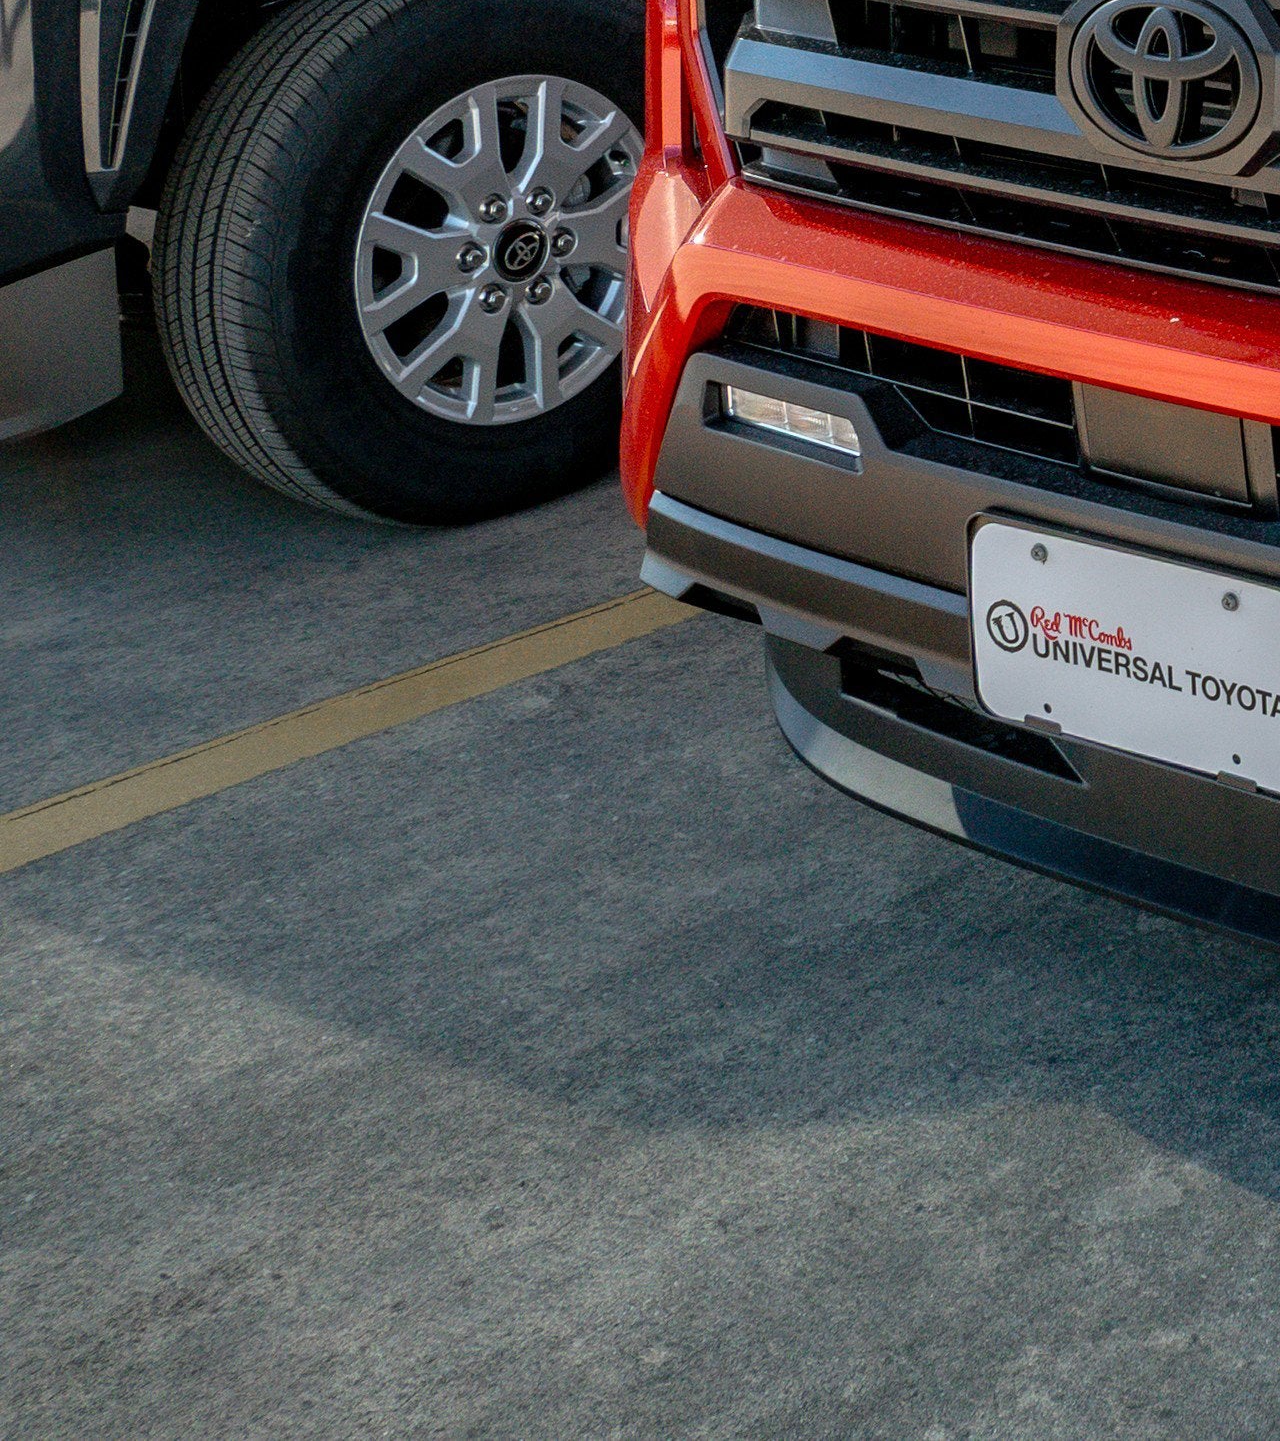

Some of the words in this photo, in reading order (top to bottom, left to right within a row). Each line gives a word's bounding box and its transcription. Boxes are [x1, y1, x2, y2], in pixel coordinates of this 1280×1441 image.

[1031, 606, 1061, 641] Red
[1063, 612, 1132, 651] McCombs
[1033, 633, 1183, 692] UNIVERSAL
